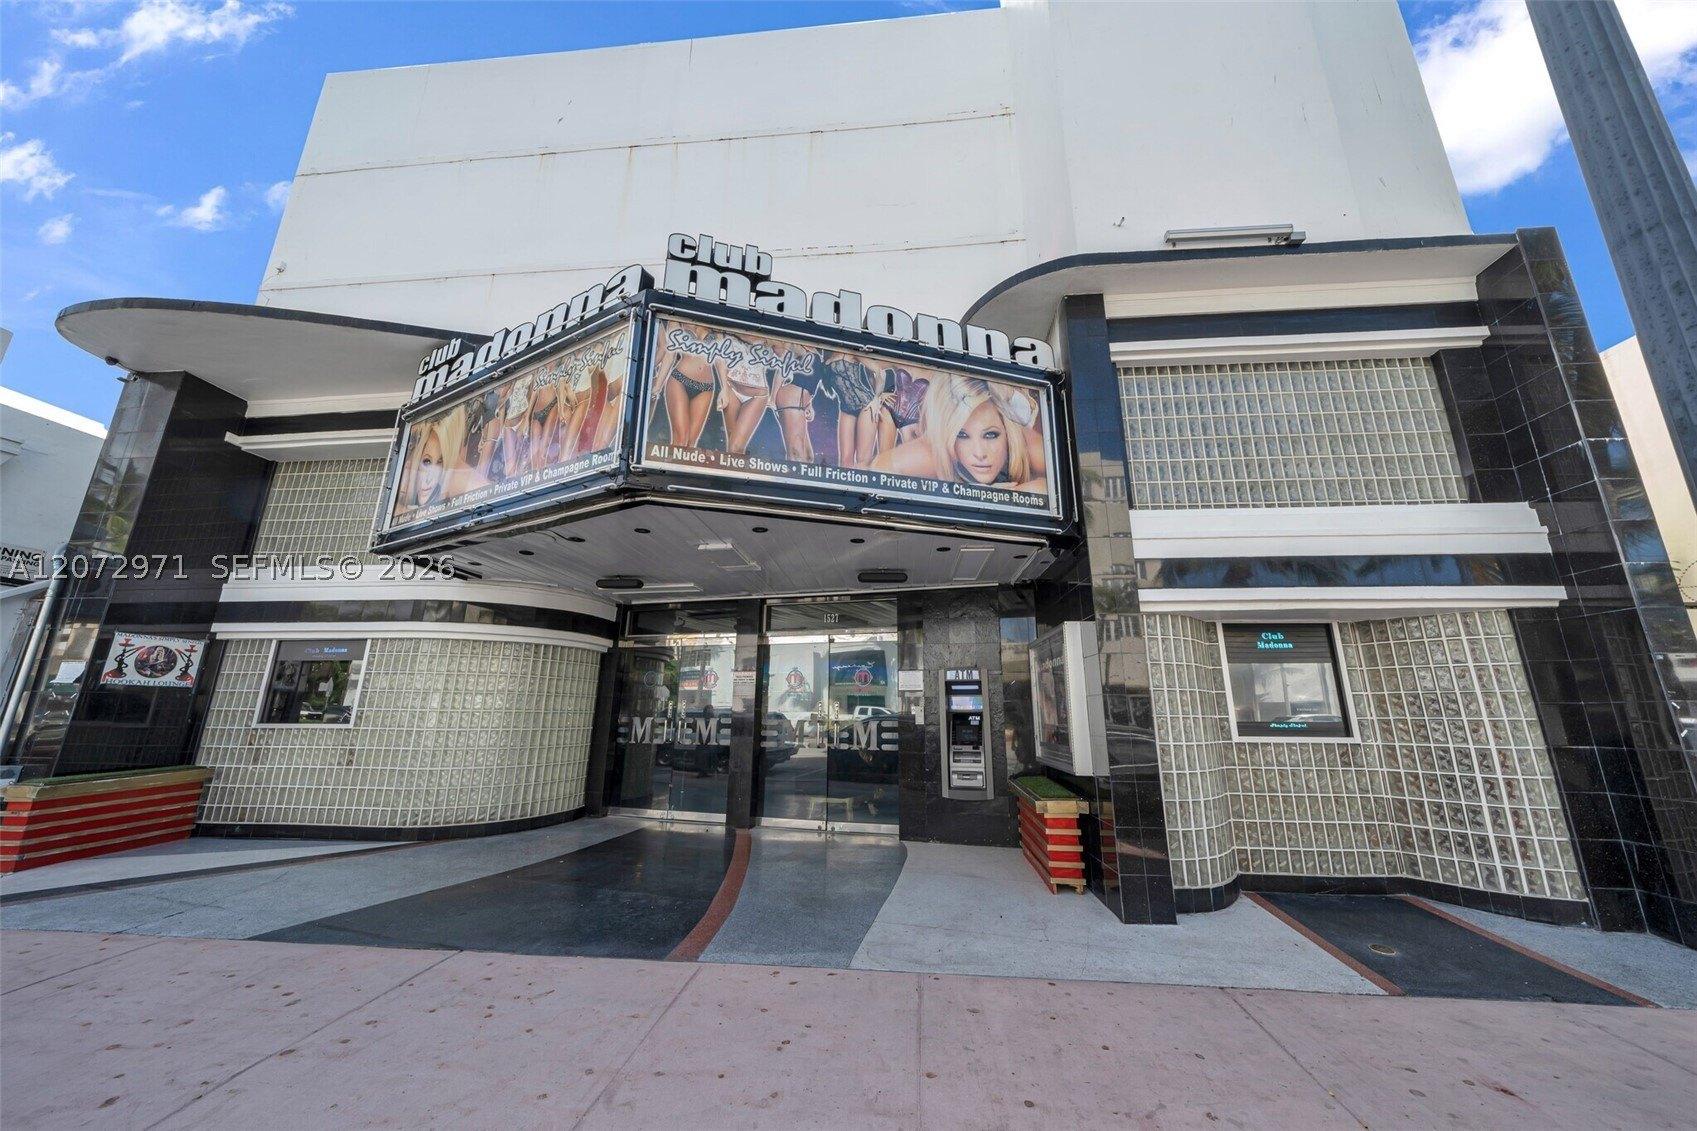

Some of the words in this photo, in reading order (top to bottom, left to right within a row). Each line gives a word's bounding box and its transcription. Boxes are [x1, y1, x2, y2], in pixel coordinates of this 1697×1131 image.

[667, 232, 773, 276] club
[664, 258, 1056, 369] madonna
[410, 264, 645, 403] madonna
[580, 332, 625, 371] Sinful
[667, 328, 743, 368] Simply
[749, 343, 813, 377] Sinful
[417, 338, 463, 375] club
[463, 489, 487, 504] Friction
[494, 479, 519, 495] Private
[520, 474, 533, 488] VIP
[542, 459, 589, 480] Champagne
[650, 444, 668, 458] All
[672, 448, 706, 463] Nude
[719, 453, 745, 468] Live
[749, 458, 788, 473] Shows
[801, 464, 822, 478] Full
[825, 467, 868, 483] Friction
[880, 474, 918, 490] Private
[920, 479, 938, 493] VIP
[941, 482, 950, 494] &
[953, 483, 1009, 502] Champagne
[1012, 493, 1044, 507] Rooms
[823, 613, 839, 623] 1527
[1261, 632, 1284, 640] Club
[1257, 641, 1294, 649] Madonna
[107, 678, 151, 687] HOOKAH
[152, 679, 193, 688] LOUNGE
[954, 670, 973, 681] ATM
